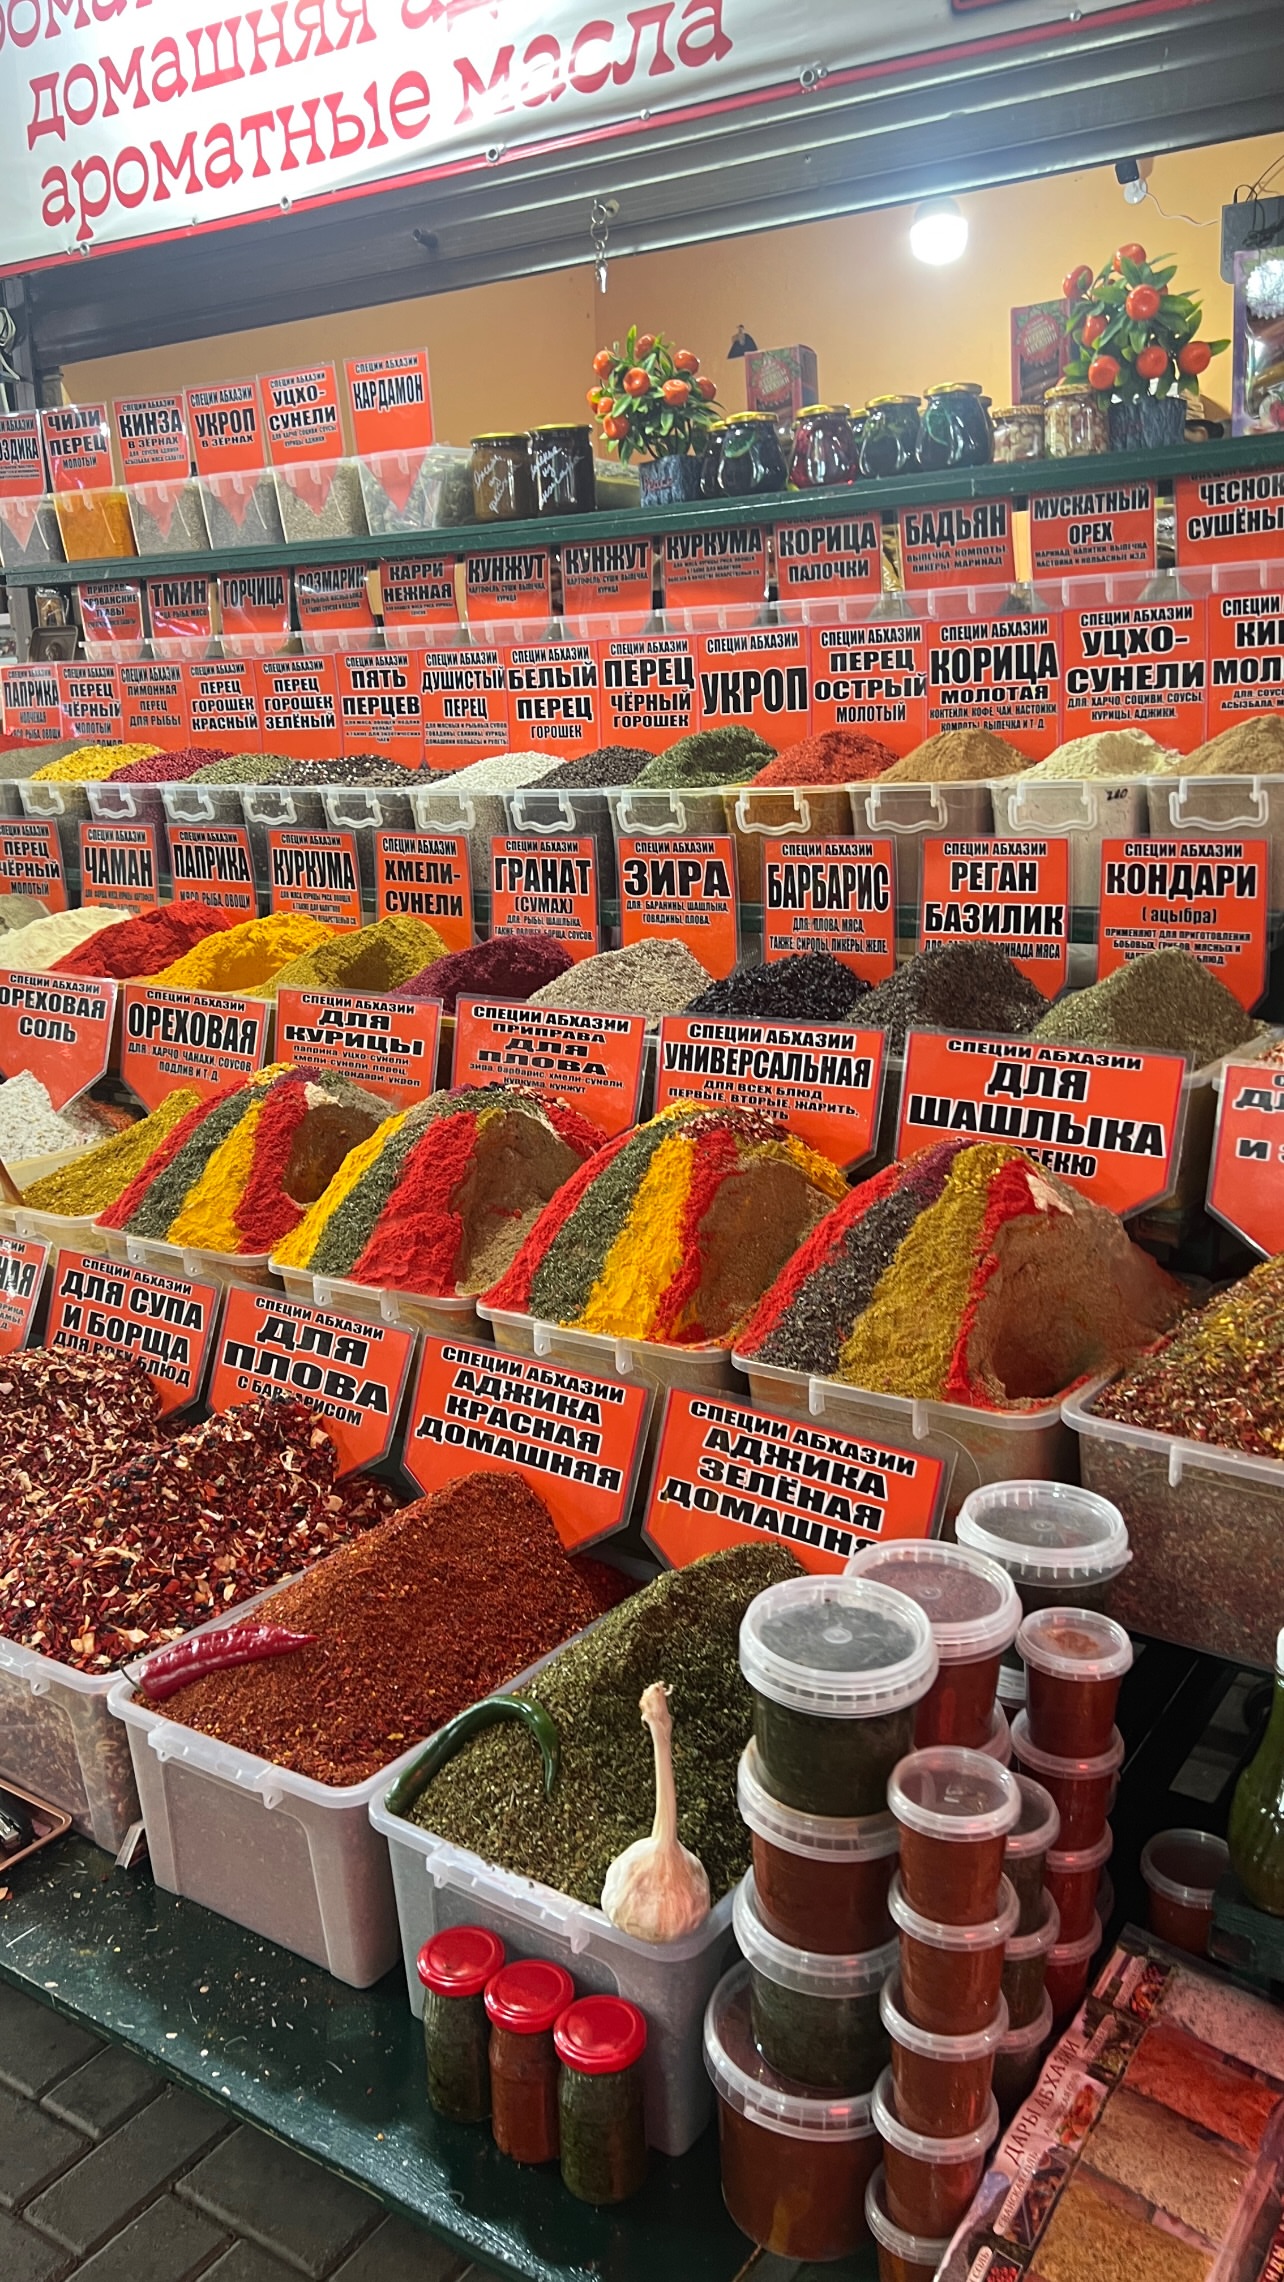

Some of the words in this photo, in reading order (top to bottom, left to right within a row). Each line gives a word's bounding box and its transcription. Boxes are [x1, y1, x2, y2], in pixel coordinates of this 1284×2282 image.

[27, 0, 378, 151] домашняя
[40, 70, 432, 241] ароматные
[453, 0, 735, 125] масла
[273, 385, 325, 408] УЦХО-
[353, 375, 423, 411] КАРДАМОН
[48, 410, 100, 431] ЧИЛИ
[120, 409, 183, 438] КИНЗА
[195, 409, 256, 437] УКРОП
[270, 407, 336, 431] СУНЕЛИ
[50, 434, 107, 456] ПЕРЕЦ
[139, 438, 178, 448] ЗЁРНАХ
[202, 440, 208, 448] В
[212, 434, 253, 447] ЗЁРНАХ
[1034, 486, 1149, 520] МУСКАТНЫЙ
[1201, 474, 1284, 506] ЧЕСНОК
[906, 504, 1007, 547] БАДЬЯН
[1069, 522, 1112, 545] ОРЕХ
[1189, 507, 1284, 539] СУШЁНЫ
[667, 528, 762, 561] КУРКУМА
[779, 522, 877, 557] КОРИЦА
[390, 563, 443, 581] КАРРИ
[468, 554, 546, 583] КУНЖУТ
[566, 542, 649, 574] КУНЖУТ
[789, 560, 869, 583] ПАЛОЧКИ
[151, 581, 206, 608] ТМИН
[222, 576, 284, 608] ГОРЧИЦА
[300, 567, 364, 595] РОЗМАРИН
[383, 583, 451, 602] НЕЖНАЯ
[1081, 611, 1129, 627] СПЕЦИИ
[1133, 607, 1192, 622] АБХАЗИИ
[1223, 596, 1279, 617] СПЕЦИИ
[1082, 626, 1188, 658] УЦХО-
[605, 658, 695, 689] ПЕРЕЦ
[831, 650, 914, 673] ПЕРЕЦ
[931, 642, 1058, 685] КОРИЦА
[201, 679, 241, 695] ПЕРЕЦ
[274, 677, 319, 694] ПЕРЕЦ
[352, 670, 407, 689] ПЯТЬ
[422, 667, 505, 692] ДУШИСТЫЙ
[508, 662, 598, 690] БЕЛЫЙ
[815, 673, 927, 701] ОСТРЫЙ
[1067, 662, 1204, 694] СУНЕЛИ
[4, 680, 59, 708] ПАПРИКА
[70, 683, 113, 699] ПЕРЕЦ
[264, 696, 333, 712] ГОРОШЕК
[611, 690, 691, 711] ЧЁРНЫЙ
[701, 667, 808, 716] УКРОП
[941, 686, 1049, 705] МОЛОТАЯ
[63, 699, 121, 718] ЧЁРНЫЙ
[140, 700, 167, 712] ПЕРЕЦ
[192, 698, 254, 713] ГОРОШЕК
[343, 697, 420, 717] ПЕРЦЕВ
[444, 698, 488, 720] ПЕРЕЦ
[518, 697, 592, 721] ПЕРЕЦ
[837, 701, 906, 723] МОЛОТЫЙ
[192, 712, 257, 731] КРАСНЫЙ
[265, 712, 334, 730] ЗЕЛЁНЫЙ
[531, 725, 582, 739] ГОРОШЕК
[614, 715, 689, 727] ГОРОШЕК
[5, 841, 49, 859] ПЕРЕЦ
[174, 844, 249, 882] ПАПРИКА
[0, 859, 60, 878] ЧЁРНЫЙ
[85, 847, 153, 887] ЧАМАН
[273, 849, 355, 891] КУРКУМА
[385, 862, 461, 885] ХМЕЛИ-
[495, 857, 591, 895] ГРАНАТ
[624, 859, 731, 898] ЗИРА
[951, 862, 1037, 892] РЕГАН
[768, 864, 889, 912] БАРБАРИС
[1106, 863, 1256, 901] КОНДАРИ
[386, 891, 463, 917] СУНЕЛИ
[515, 896, 573, 915] (СУМАХ)
[646, 901, 685, 910] БАРАНИНЫ,
[925, 904, 1064, 936] БАЗИЛИК
[1195, 944, 1233, 952] МЯСНЫХ
[0, 986, 106, 1020] ОРЕХОВАЯ
[20, 1017, 76, 1043] СОЛЬ
[128, 1004, 257, 1056] ОРЕХОВАЯ
[318, 1009, 391, 1031] ДЛЯ
[472, 1005, 543, 1025] СПЕЦИИ
[545, 1012, 629, 1032] АБХАЗИИ
[285, 1026, 423, 1057] КУРИЦЫ
[492, 1023, 606, 1043] ПРИПРАВА
[689, 1022, 762, 1043] СПЕЦИИ
[764, 1029, 854, 1050] АБХАЗИИ
[505, 1038, 588, 1057] ДЛЯ
[948, 1040, 1032, 1059] СПЕЦИИ
[1038, 1049, 1142, 1070] АБХАЗИИ
[159, 1061, 193, 1076] ПОДЛИВ
[196, 1068, 201, 1077] И
[478, 1050, 606, 1076] ПЛОВА
[664, 1042, 871, 1088] УНИВЕРСАЛЬНАЯ
[704, 1079, 736, 1091] ДЛЯ
[738, 1083, 773, 1095] ВСЕХ
[776, 1087, 822, 1101] БЛЮД
[987, 1062, 1089, 1101] ДЛЯ
[908, 1095, 1164, 1157] ШАШЛЫКА
[83, 1259, 130, 1278] СПЕЦИИ
[134, 1273, 191, 1295] АБХАЗИИ
[61, 1270, 124, 1306] ДЛЯ
[130, 1288, 202, 1330] СУПА
[255, 1297, 313, 1322] СПЕЦИИ
[315, 1313, 384, 1341] АБХАЗИИ
[63, 1304, 82, 1330] И
[88, 1311, 189, 1364] БОРЩА
[256, 1316, 368, 1367] ДЛЯ
[53, 1331, 89, 1352] ДЛЯ
[138, 1357, 191, 1387] БЛЮД
[223, 1342, 389, 1414] ПЛОВА
[442, 1346, 523, 1379] СПЕЦИИ
[525, 1365, 626, 1405] АБХАЗИИ
[237, 1375, 249, 1389] С
[251, 1379, 362, 1426] БАРАРИСОМ
[454, 1368, 601, 1426] АДЖИКА
[446, 1395, 601, 1456] КРАСНАЯ
[690, 1401, 787, 1440] СПЕЦИИ
[792, 1428, 916, 1477] АБХАЗИИ
[416, 1417, 622, 1494] ДОМАШНЯЯ
[703, 1432, 886, 1499] АДЖИКА
[698, 1458, 882, 1532] ЗЕЛЁНАЯ
[660, 1479, 878, 1557] ДОМАШН
[1004, 2107, 1040, 2167] ДАРЫ
[1034, 2039, 1080, 2110] АБХАЗИИ
